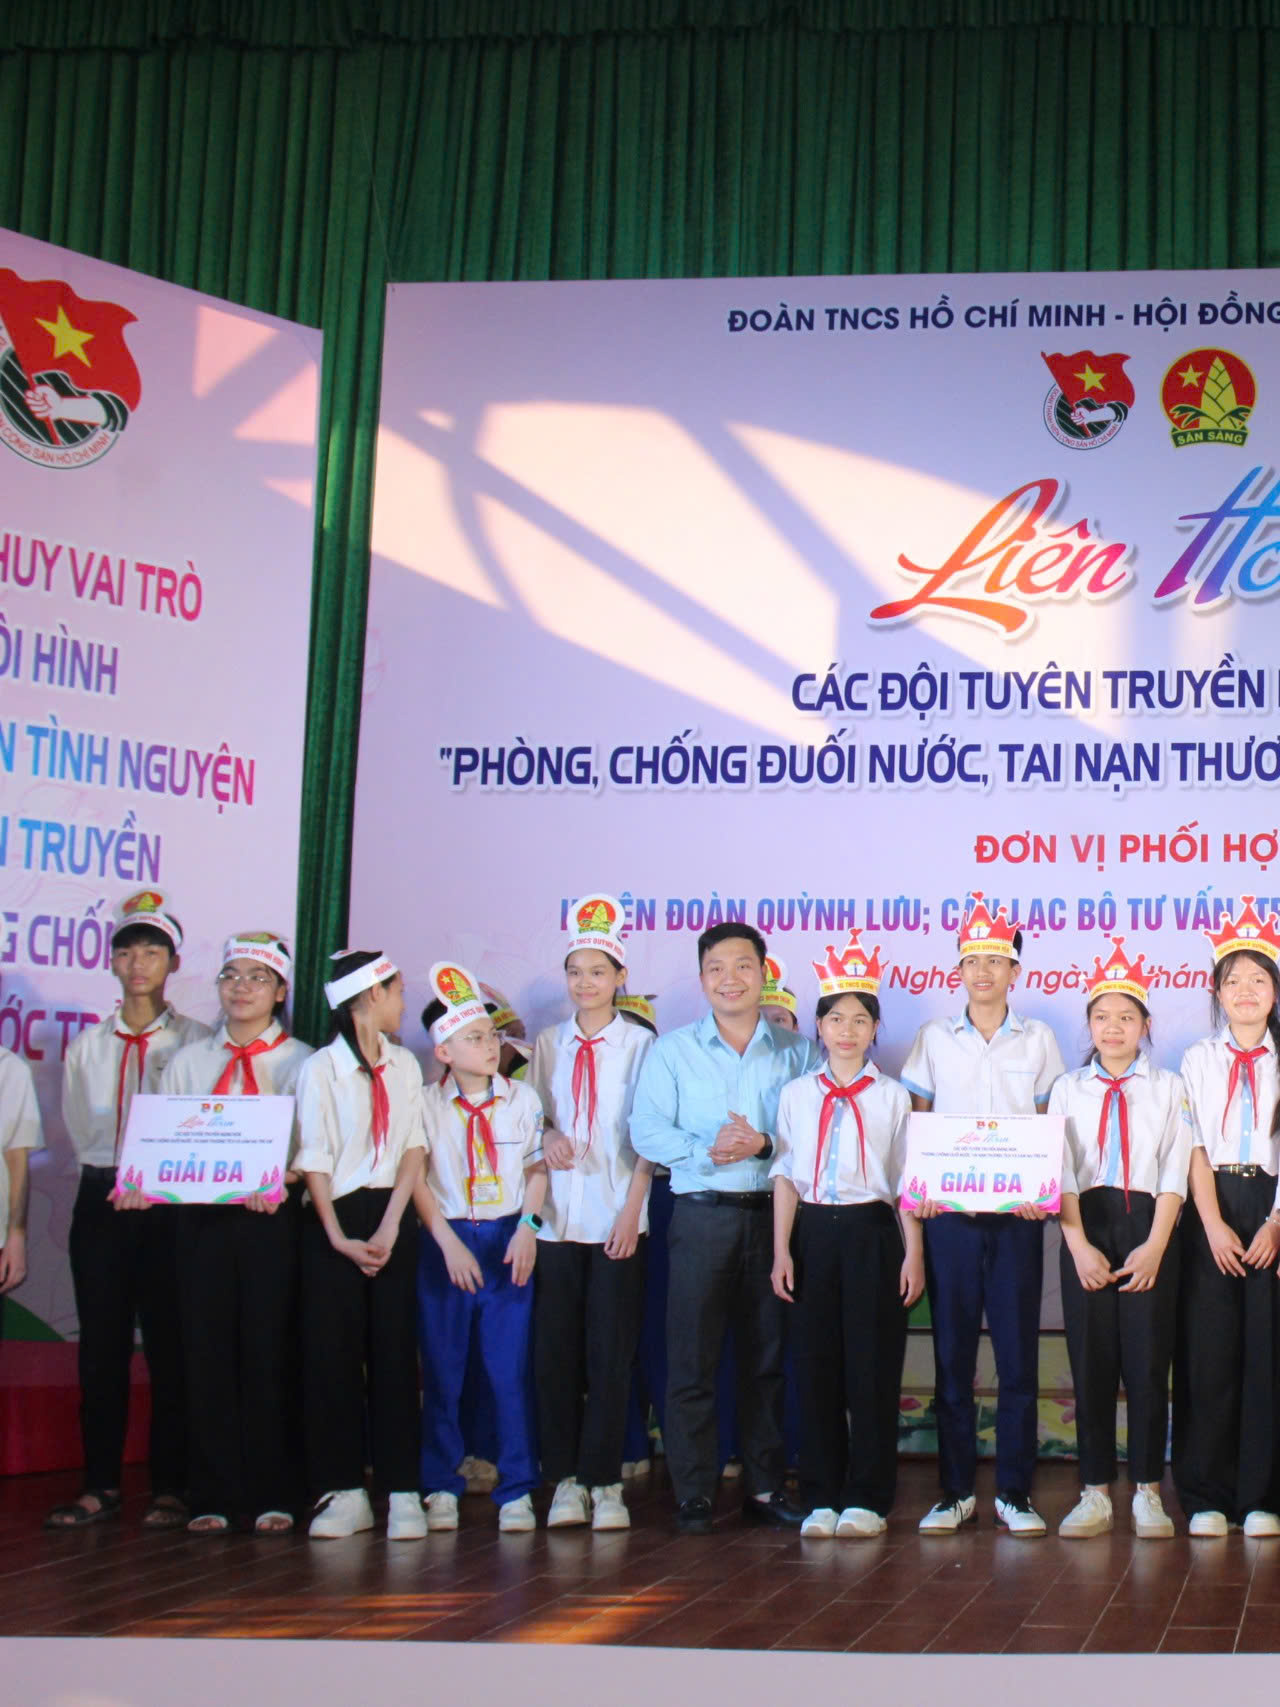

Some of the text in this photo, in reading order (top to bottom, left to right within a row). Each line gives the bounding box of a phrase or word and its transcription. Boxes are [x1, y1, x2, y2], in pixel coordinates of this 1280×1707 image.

[727, 303, 815, 332] ĐOÀN
[825, 307, 900, 331] TNCS
[910, 294, 954, 329] HỒ
[965, 299, 1018, 328] CHÍ
[1028, 304, 1105, 328] MINH
[1133, 297, 1187, 332] HỘI
[69, 547, 126, 607] VAI
[135, 560, 202, 622] TRÒ
[869, 478, 1126, 633] Liên
[33, 623, 119, 695] HÌNH
[792, 663, 869, 711] CÁC
[878, 662, 947, 720] ĐỘI
[959, 660, 1092, 711] TUYÊN
[1103, 654, 1265, 709] TRUYỀN
[26, 714, 109, 785] TÌNH
[119, 742, 255, 814] NGUYỆN
[609, 729, 747, 785] CHỐNG
[757, 728, 856, 784] ĐUỐI
[869, 733, 988, 785] NƯỚC,
[998, 743, 1061, 782] TAI
[1075, 742, 1160, 792] NẠN
[19, 810, 161, 883] TRUYỀN
[973, 831, 1057, 864] ĐƠN
[1071, 834, 1105, 872] VỊ
[1119, 820, 1209, 864] PHỐI
[666, 891, 746, 932] ĐOÀN
[757, 893, 856, 933] QUỲNH
[865, 895, 930, 935] LƯU;
[1011, 898, 1067, 941] LẠC
[1077, 891, 1118, 938] BỘ
[1127, 895, 1168, 931] TƯ
[1174, 885, 1235, 931] VẤN
[889, 961, 962, 995] Nghệ
[158, 1152, 243, 1183] GIẢI BA
[940, 1165, 1023, 1194] GIẢI BA
